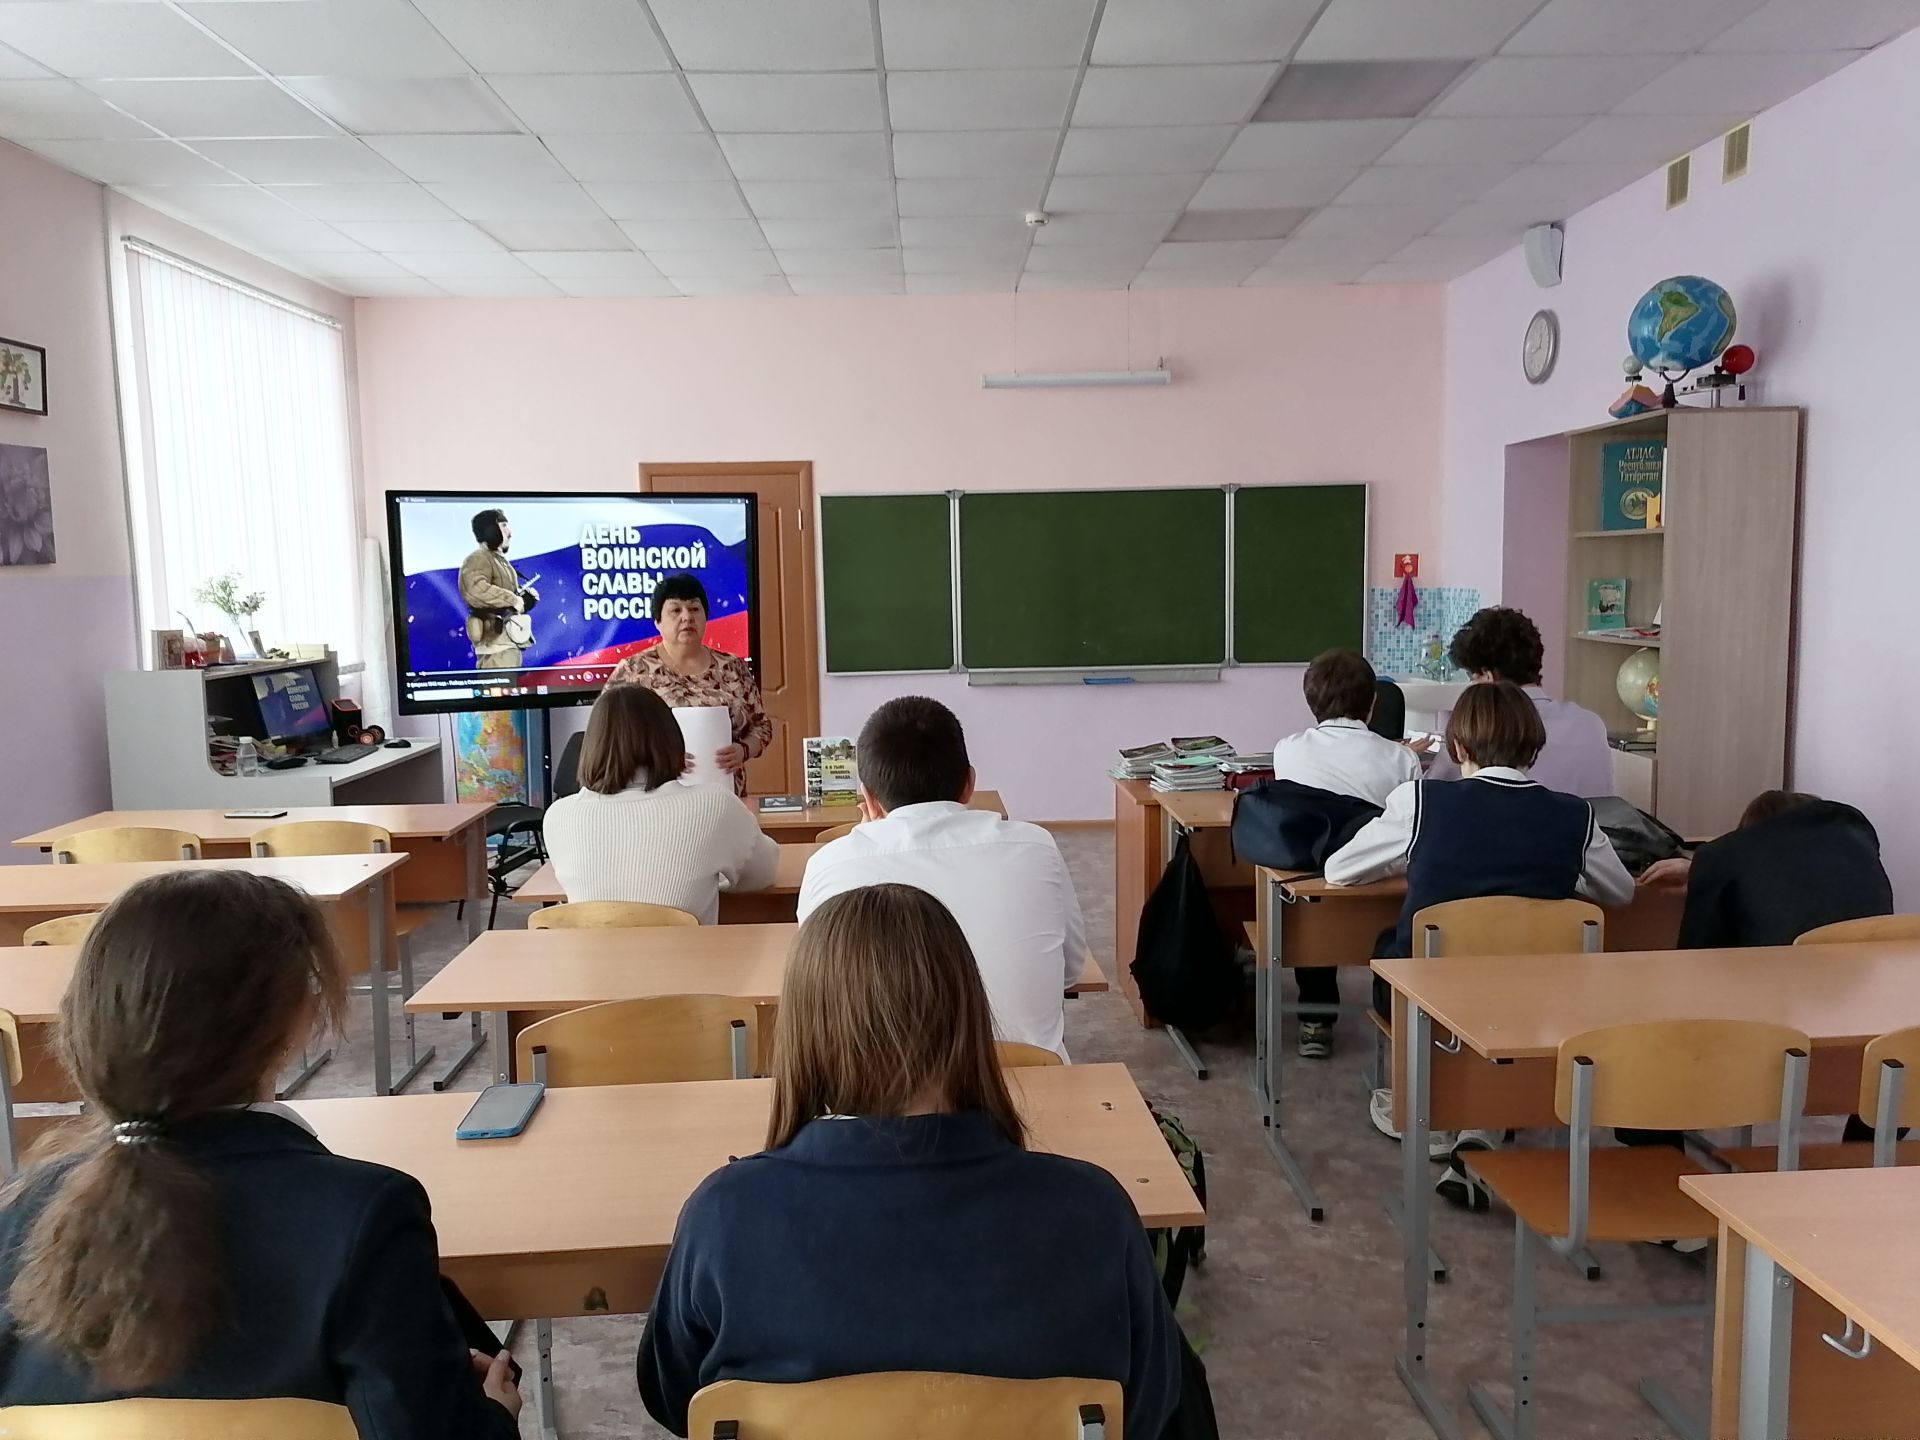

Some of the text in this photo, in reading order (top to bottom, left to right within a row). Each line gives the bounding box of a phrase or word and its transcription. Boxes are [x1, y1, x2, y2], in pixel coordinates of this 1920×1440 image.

[1624, 446, 1656, 460] АТЛАС
[580, 522, 641, 548] ДЕНЬ
[581, 540, 706, 570] ВОИНСКОЙ
[583, 597, 652, 620] РОСС
